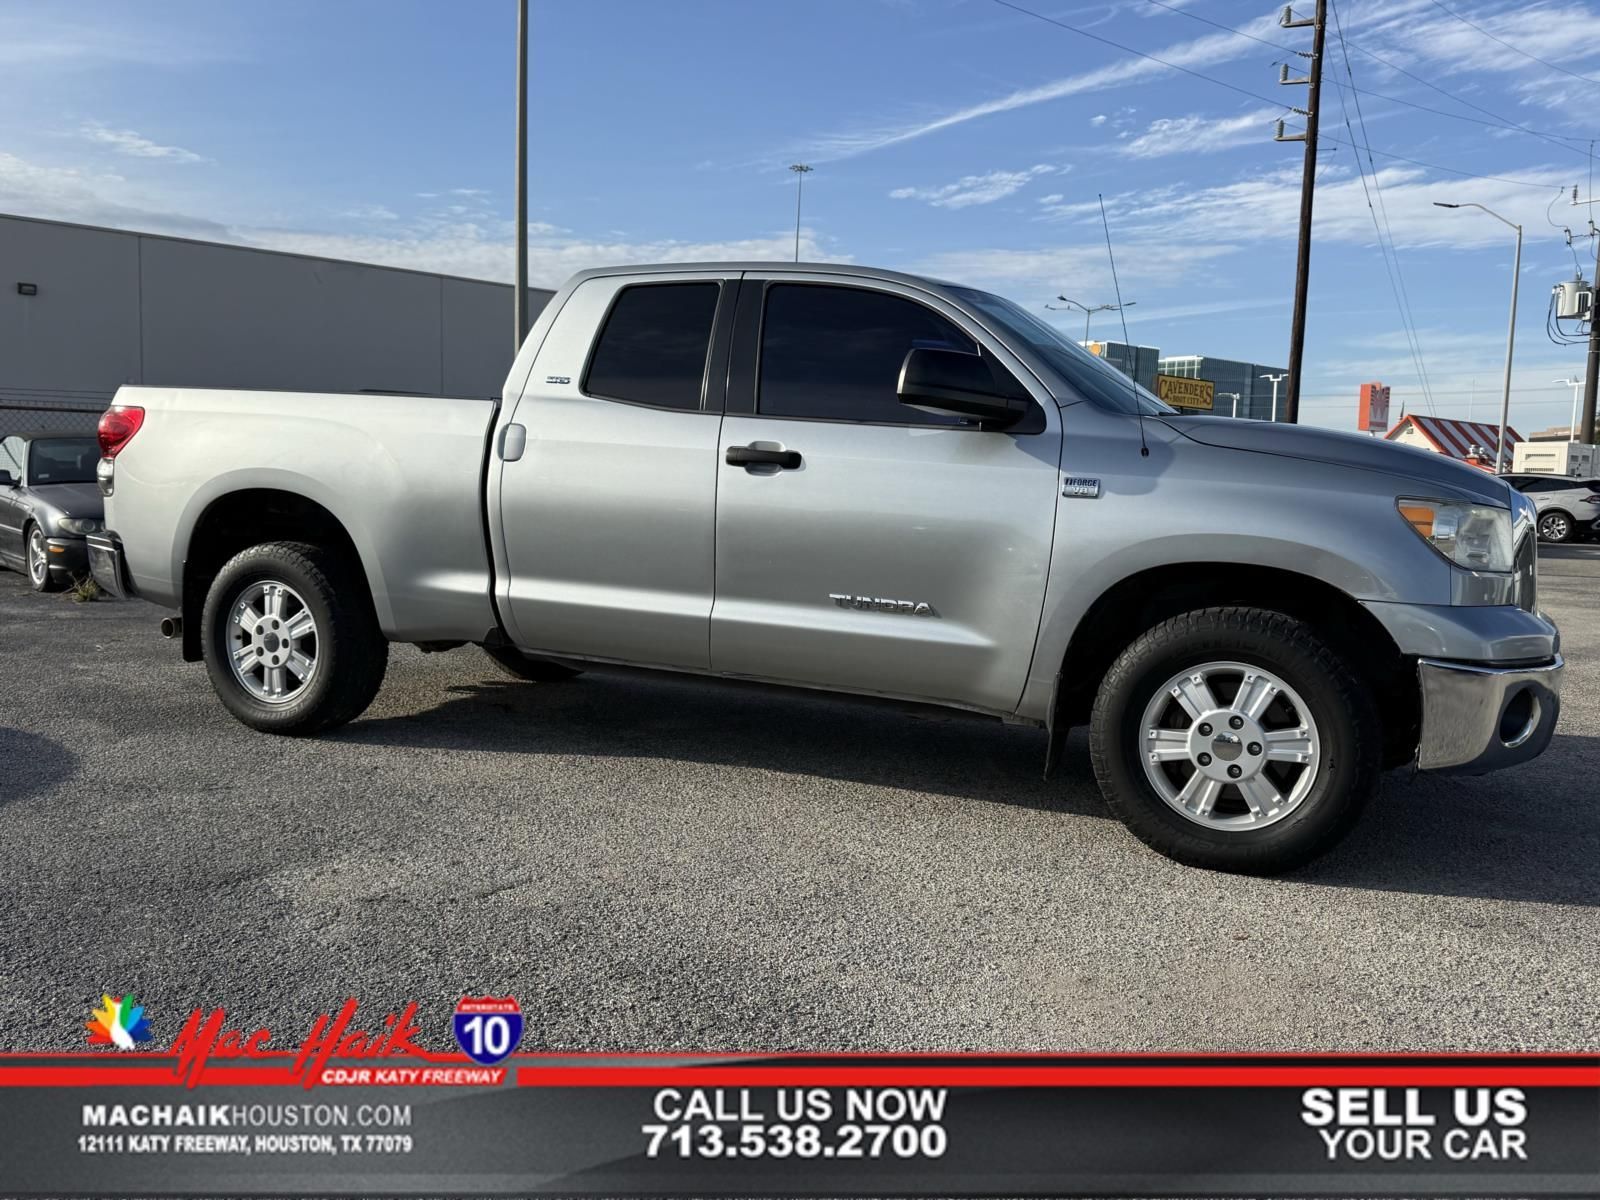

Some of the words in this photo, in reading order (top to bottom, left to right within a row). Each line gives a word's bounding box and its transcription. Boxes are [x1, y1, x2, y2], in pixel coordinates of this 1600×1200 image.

[1160, 379, 1212, 405] CAVENDER'S
[1187, 396, 1200, 405] CITY
[829, 593, 937, 616] TUNDRA
